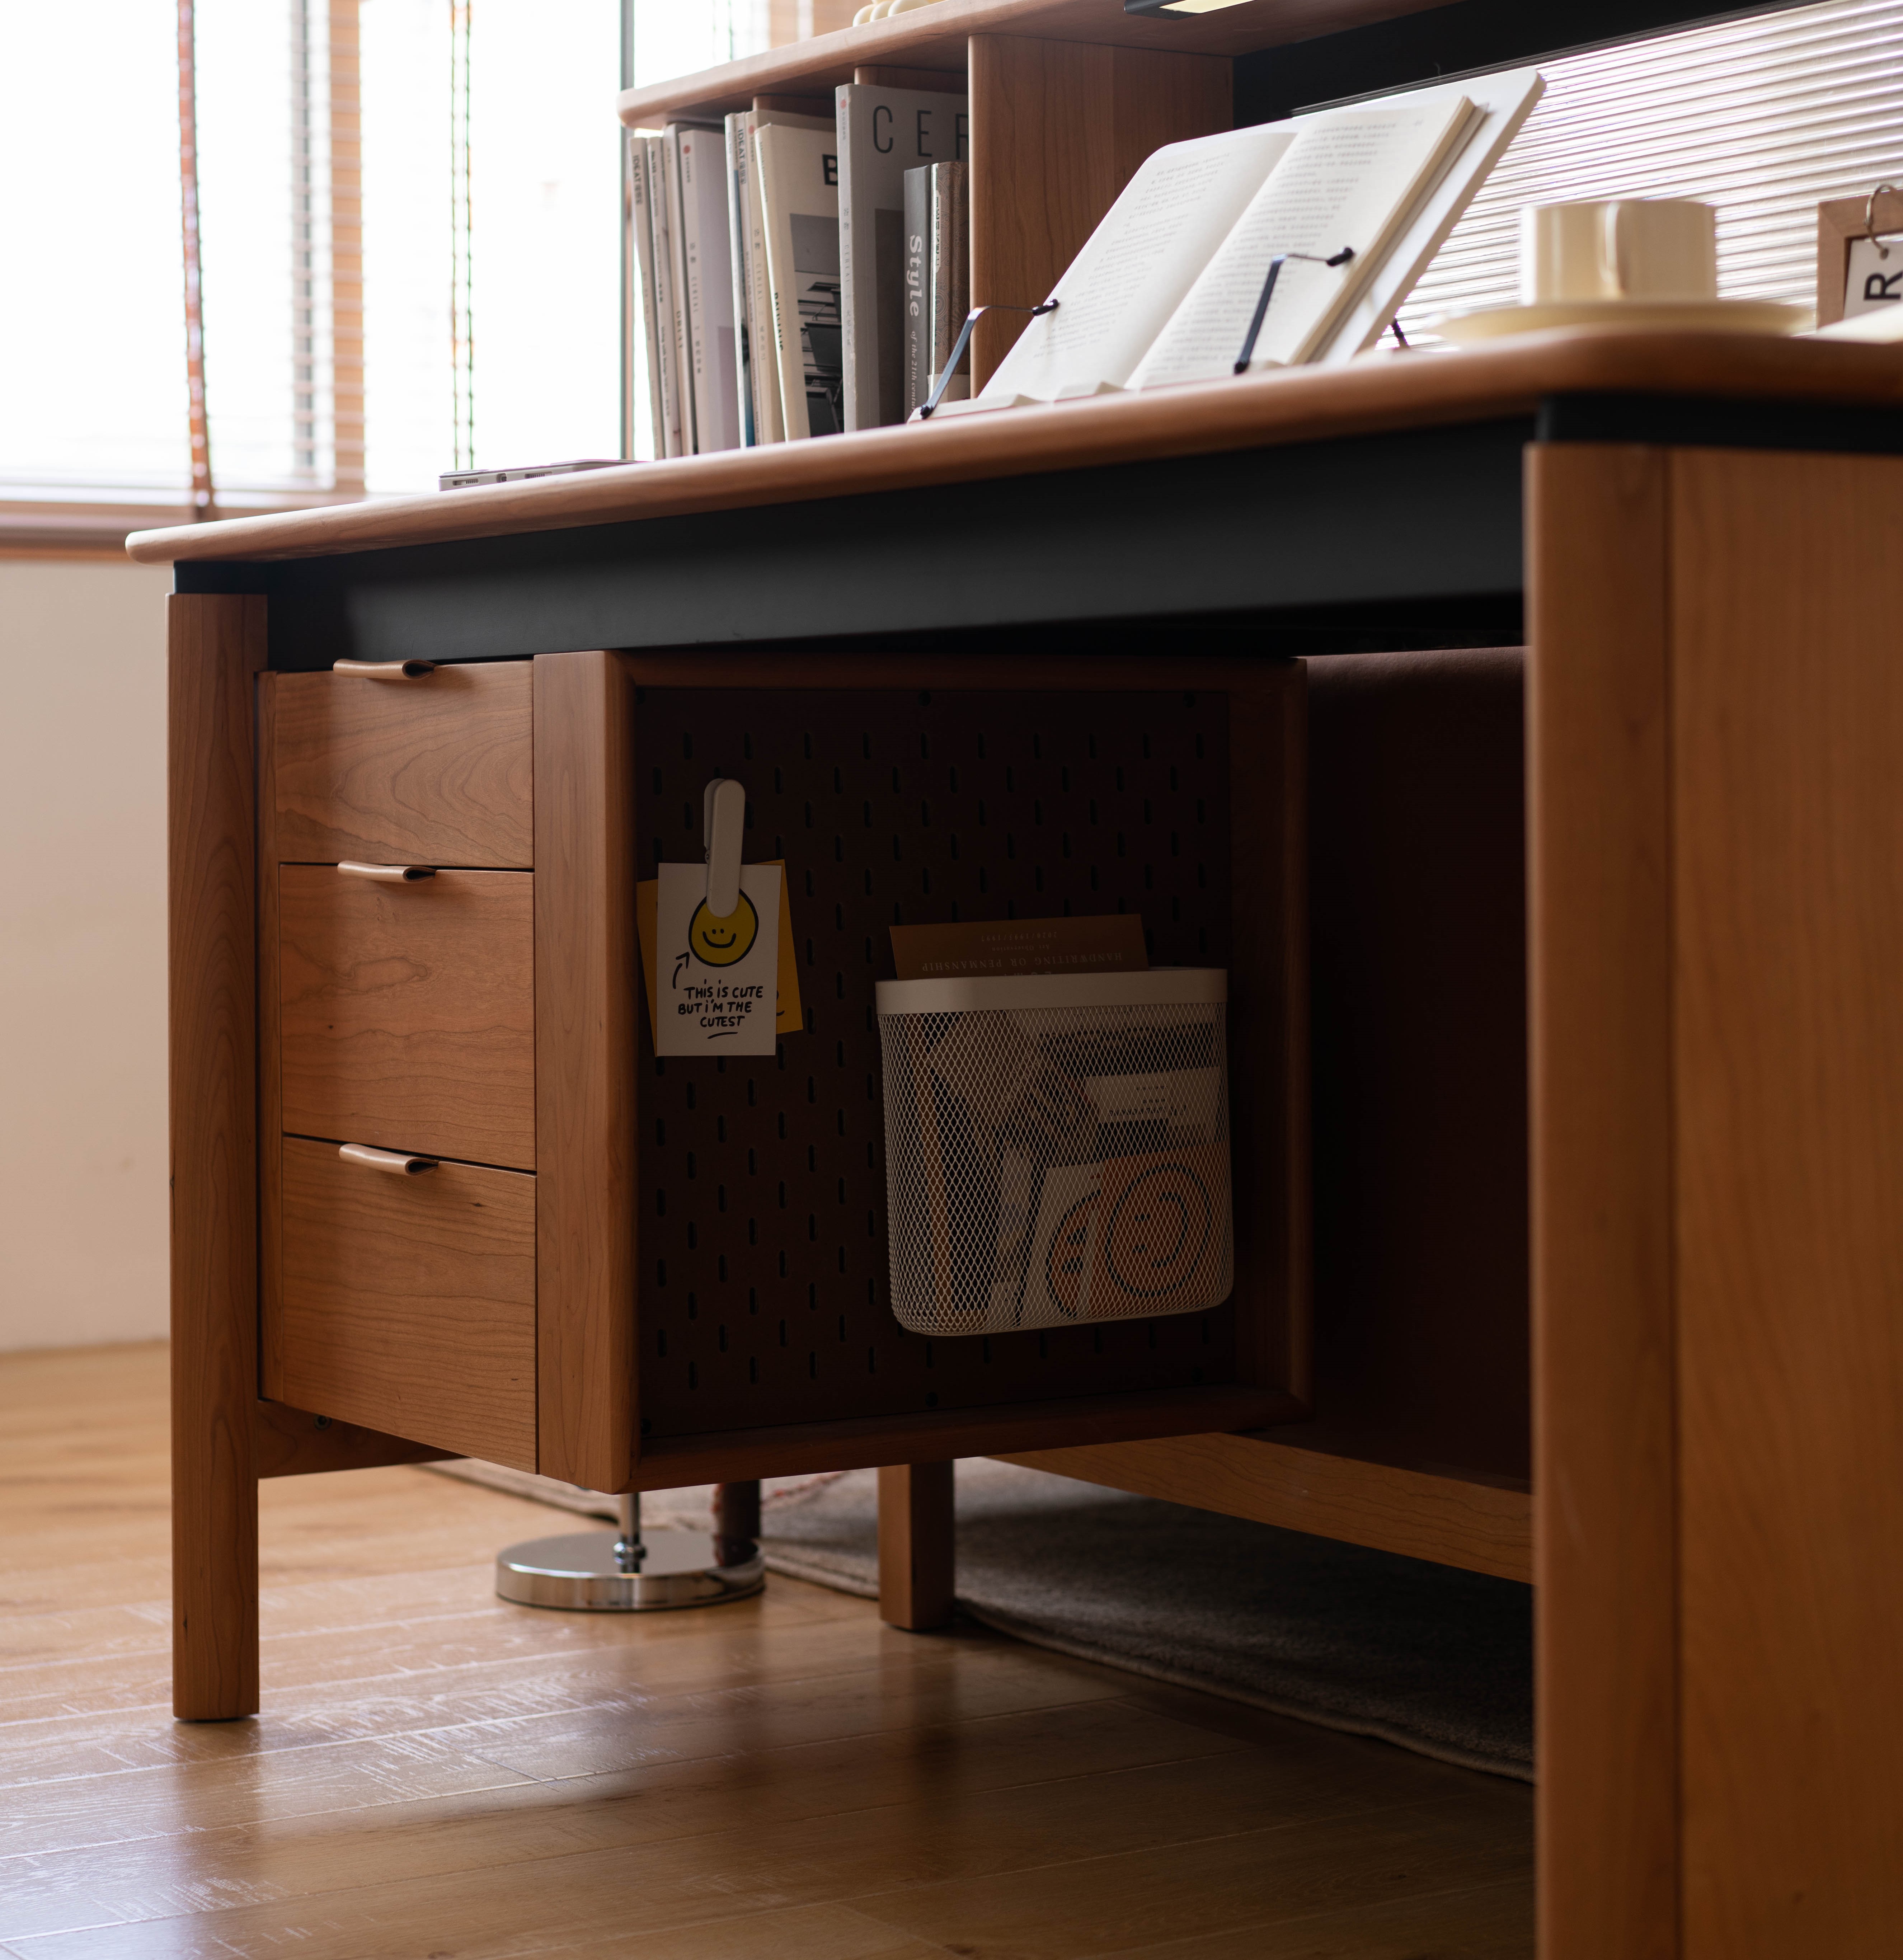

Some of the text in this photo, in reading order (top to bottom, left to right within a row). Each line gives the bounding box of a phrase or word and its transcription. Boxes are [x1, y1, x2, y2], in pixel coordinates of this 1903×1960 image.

[738, 128, 746, 160] IDEAT
[906, 235, 922, 316] Style
[910, 331, 917, 342] of
[922, 952, 1122, 972] HANDWRITING OR PENMANSHIP
[732, 986, 763, 998] CUTE
[678, 1002, 703, 1015] BUT
[727, 1001, 752, 1013] THE
[700, 1015, 745, 1028] CUTEST
